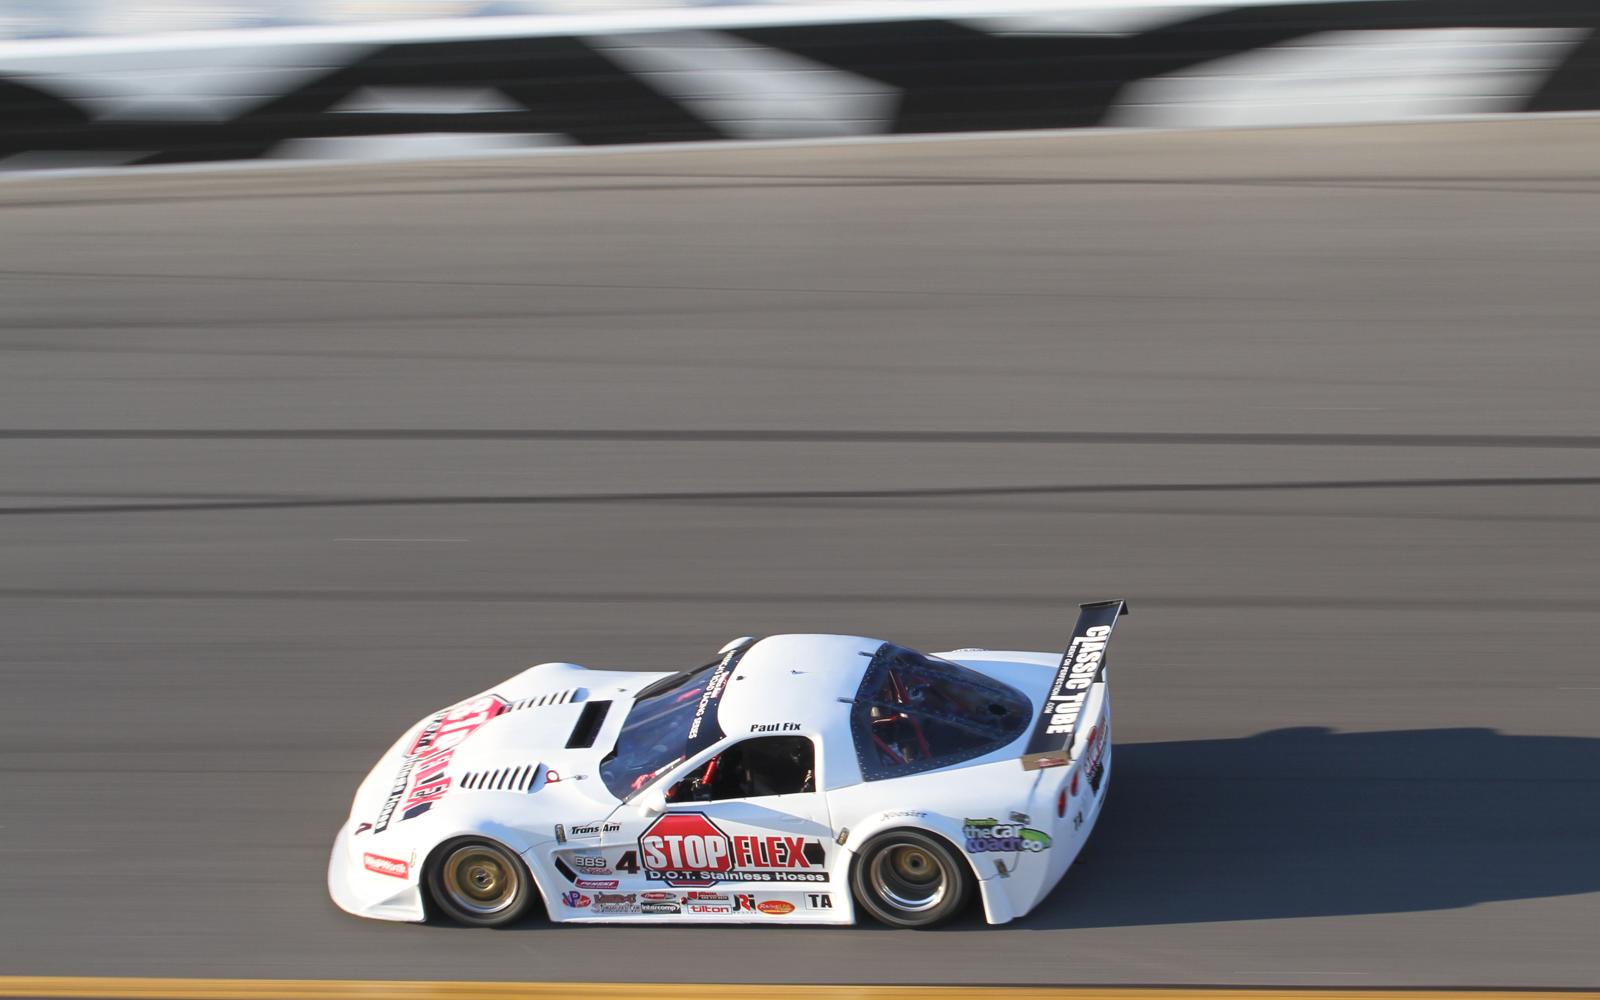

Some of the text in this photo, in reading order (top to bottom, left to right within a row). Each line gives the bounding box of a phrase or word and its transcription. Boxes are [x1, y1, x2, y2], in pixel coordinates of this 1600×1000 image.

[1065, 625, 1111, 690] CLASSIC
[1046, 691, 1087, 734] TUBE
[750, 722, 801, 732] Paul Fix
[570, 824, 620, 835] Trans Am
[643, 835, 810, 869] STOP FLEX
[575, 857, 606, 868] BBS
[616, 851, 640, 874] 4
[650, 871, 825, 881] D.O.T. Stainless Hoses
[808, 894, 833, 908] TA
[690, 905, 730, 913] tilton
